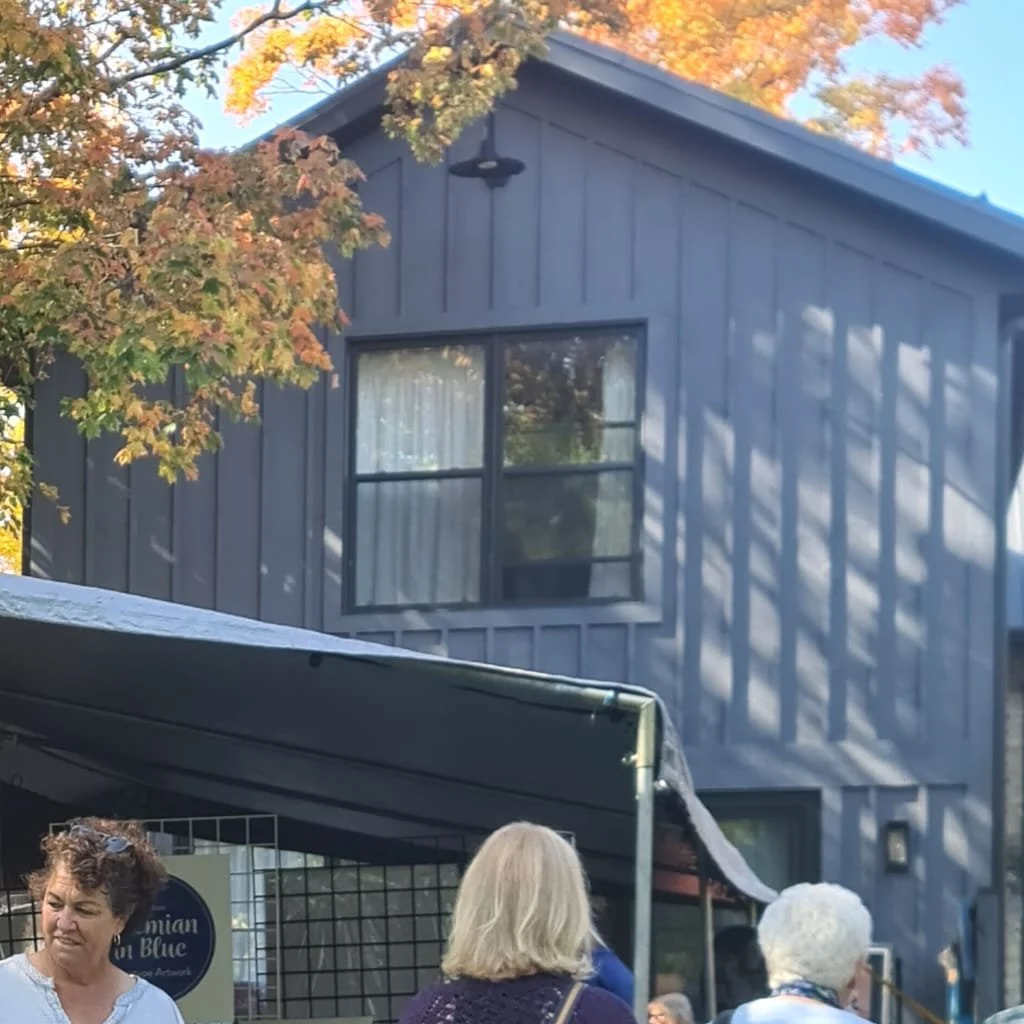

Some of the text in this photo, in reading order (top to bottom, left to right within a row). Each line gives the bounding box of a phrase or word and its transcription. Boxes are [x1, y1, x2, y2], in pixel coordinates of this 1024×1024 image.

[137, 914, 198, 936] mian
[140, 936, 187, 959] Blue
[155, 967, 192, 977] Artwork
